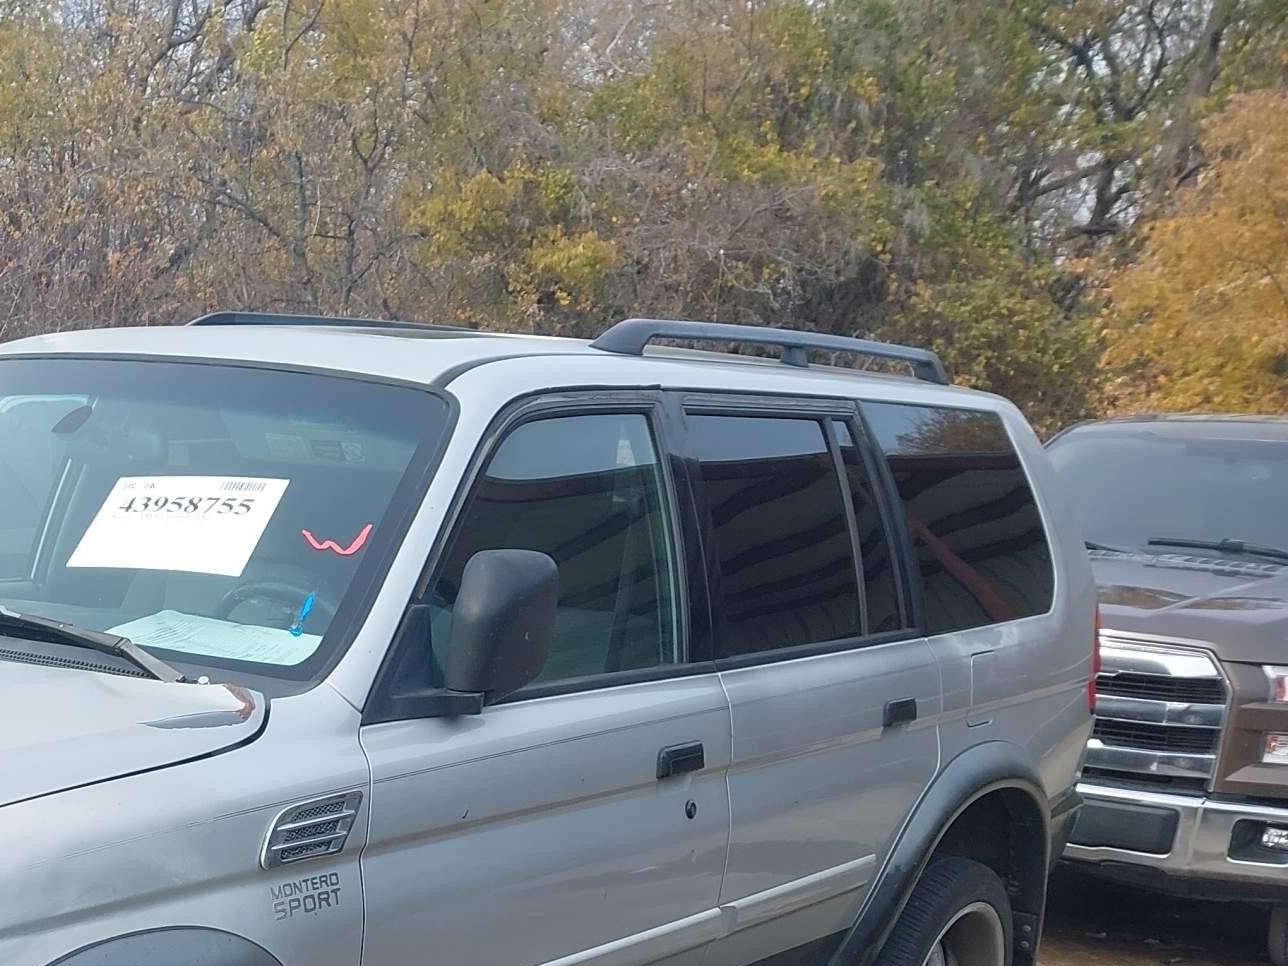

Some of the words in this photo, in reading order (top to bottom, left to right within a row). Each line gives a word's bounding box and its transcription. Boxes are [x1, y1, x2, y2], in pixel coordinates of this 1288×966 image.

[119, 496, 255, 516] 43958755
[271, 872, 340, 900] MONTERO
[273, 888, 341, 920] SPORT
